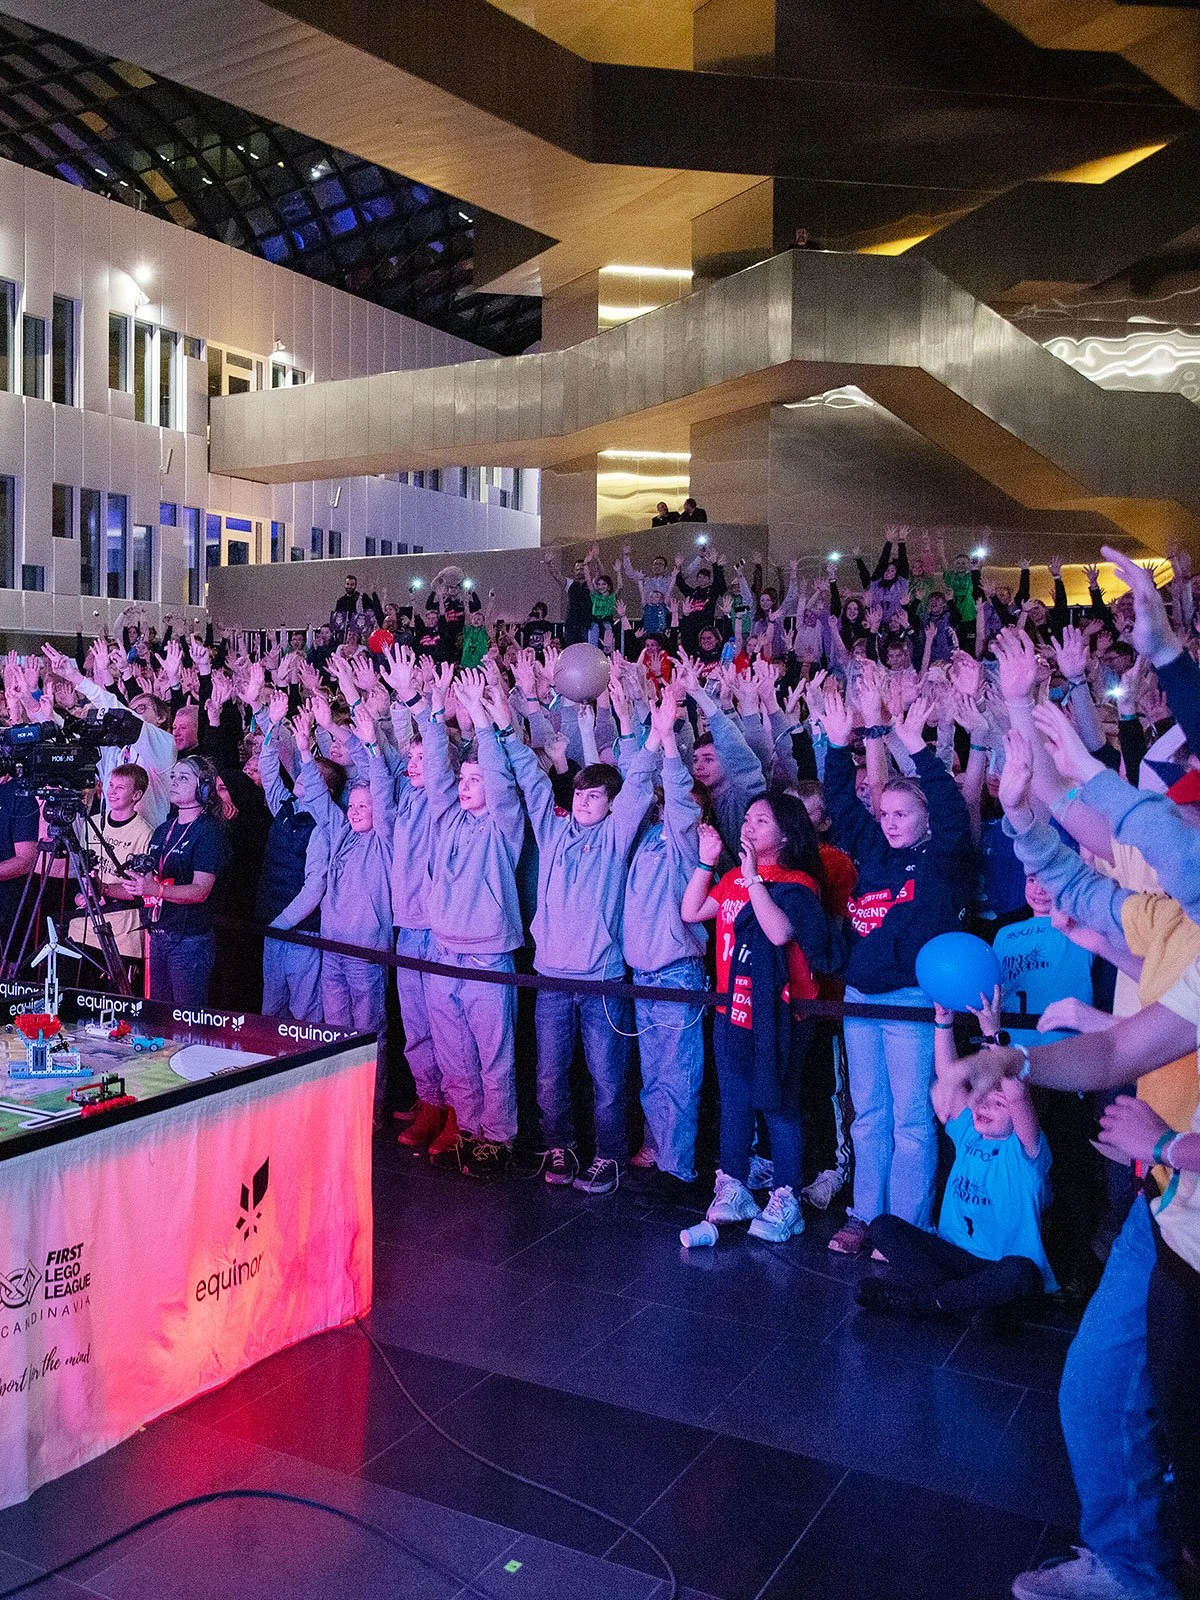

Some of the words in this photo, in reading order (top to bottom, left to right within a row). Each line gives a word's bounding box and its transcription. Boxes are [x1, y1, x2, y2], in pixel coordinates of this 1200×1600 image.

[77, 995, 128, 1013] equinor
[172, 1008, 231, 1028] equinor
[277, 1022, 341, 1044] equinor
[46, 1242, 84, 1267] FIRST
[45, 1261, 81, 1284] LEGO
[195, 1250, 265, 1302] equinor
[45, 1272, 91, 1300] LEAGUE
[41, 1345, 62, 1378] the
[65, 1342, 91, 1367] mind
